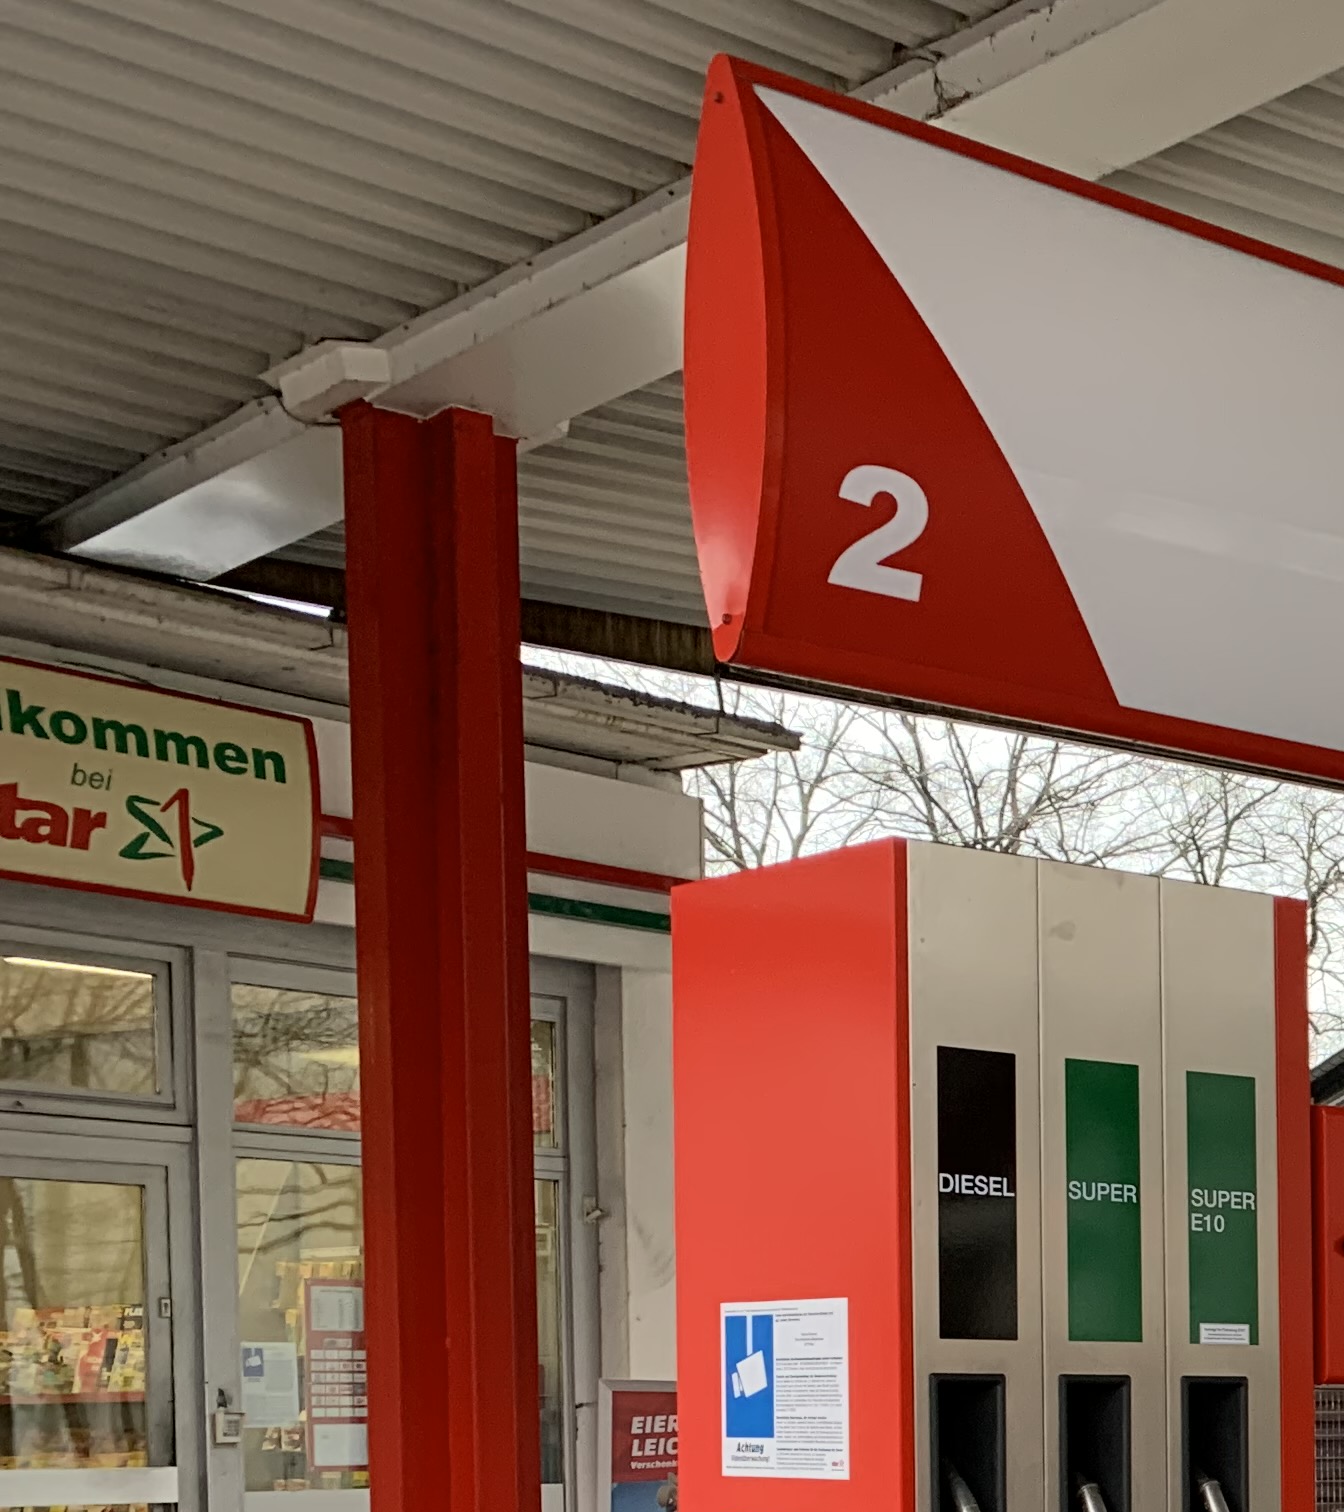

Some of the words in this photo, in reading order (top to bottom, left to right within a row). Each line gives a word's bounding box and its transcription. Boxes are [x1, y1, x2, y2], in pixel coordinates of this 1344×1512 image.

[827, 463, 930, 603] 2
[0, 689, 287, 784] kommen
[70, 762, 114, 791] bei
[938, 1172, 1015, 1198] DIESEL
[1068, 1180, 1138, 1203] SUPER
[1191, 1188, 1256, 1210] SUPER
[1191, 1213, 1226, 1234] E10
[631, 1414, 678, 1435] EIER
[736, 1442, 764, 1454] Achtung
